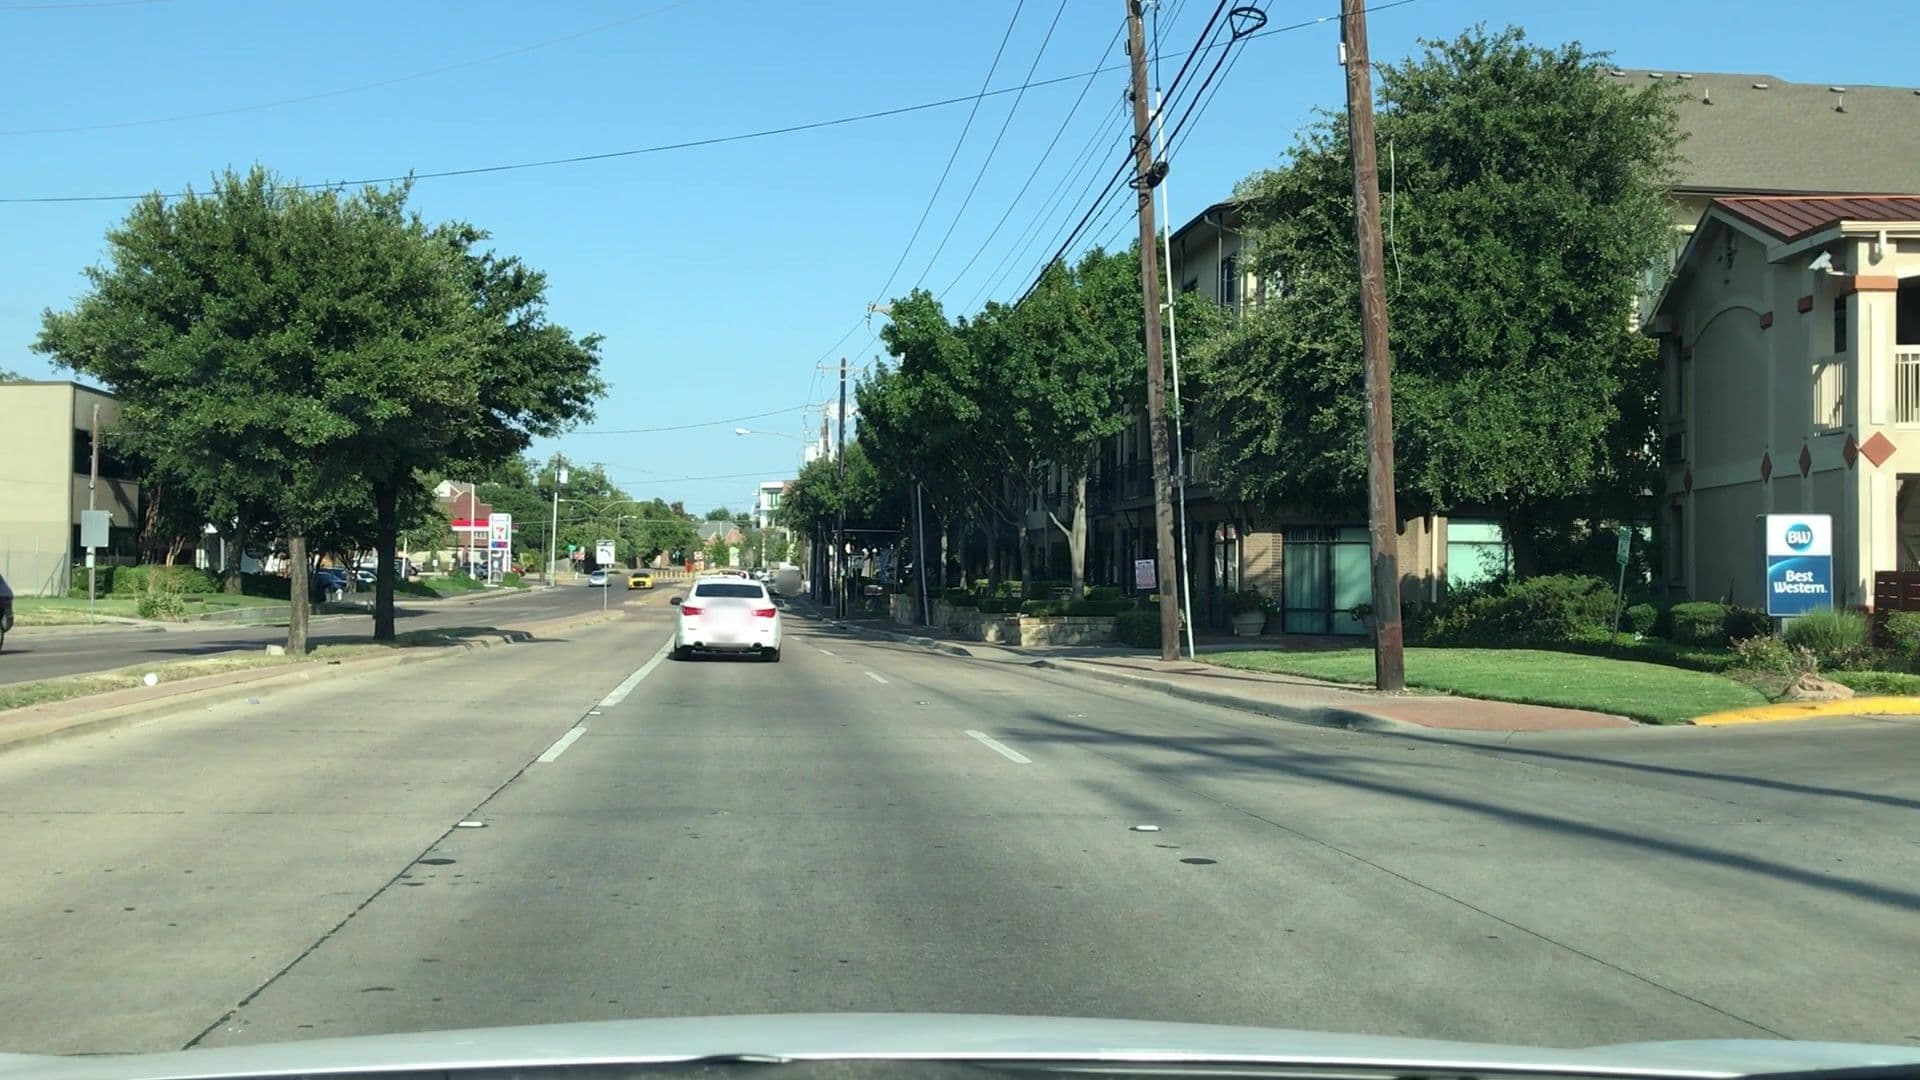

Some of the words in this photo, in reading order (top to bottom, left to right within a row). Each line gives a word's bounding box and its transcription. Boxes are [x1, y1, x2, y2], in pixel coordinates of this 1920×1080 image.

[1788, 531, 1811, 544] BW
[1786, 570, 1813, 581] Best
[1774, 582, 1825, 593] Western
